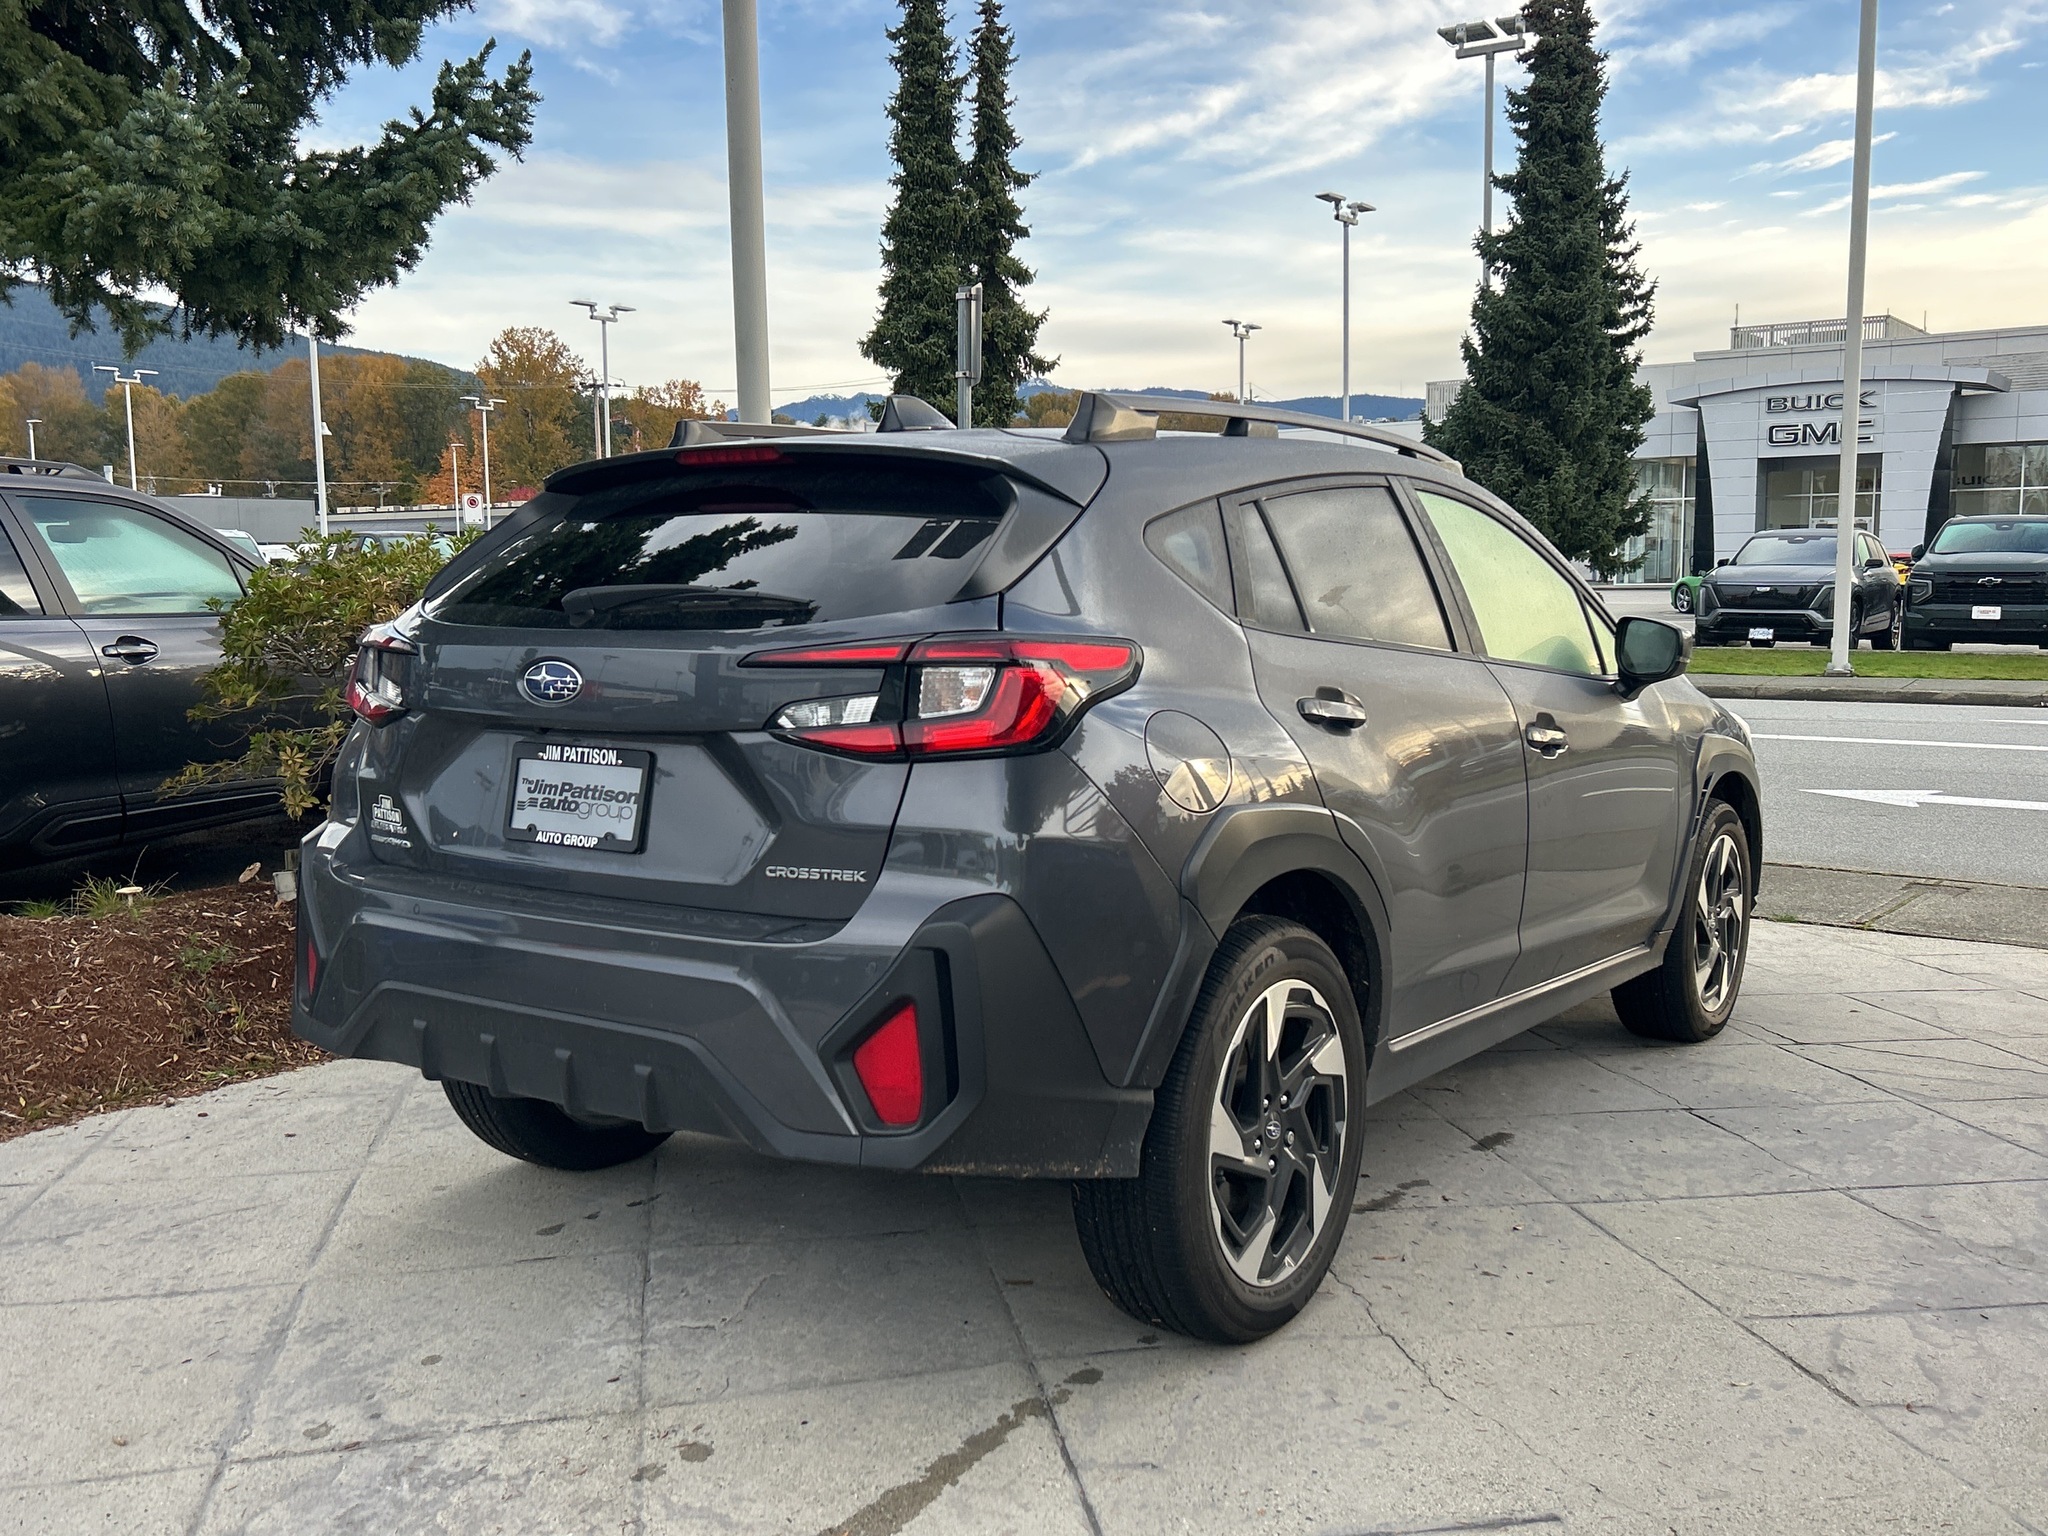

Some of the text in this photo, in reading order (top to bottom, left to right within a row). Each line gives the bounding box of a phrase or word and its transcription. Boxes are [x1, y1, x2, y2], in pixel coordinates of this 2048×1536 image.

[1766, 389, 1876, 413] BUICK
[543, 745, 617, 766] JIM PATTISON
[522, 778, 534, 786] The
[535, 831, 598, 848] AUTO GROUP
[765, 865, 867, 882] CROSSTREK
